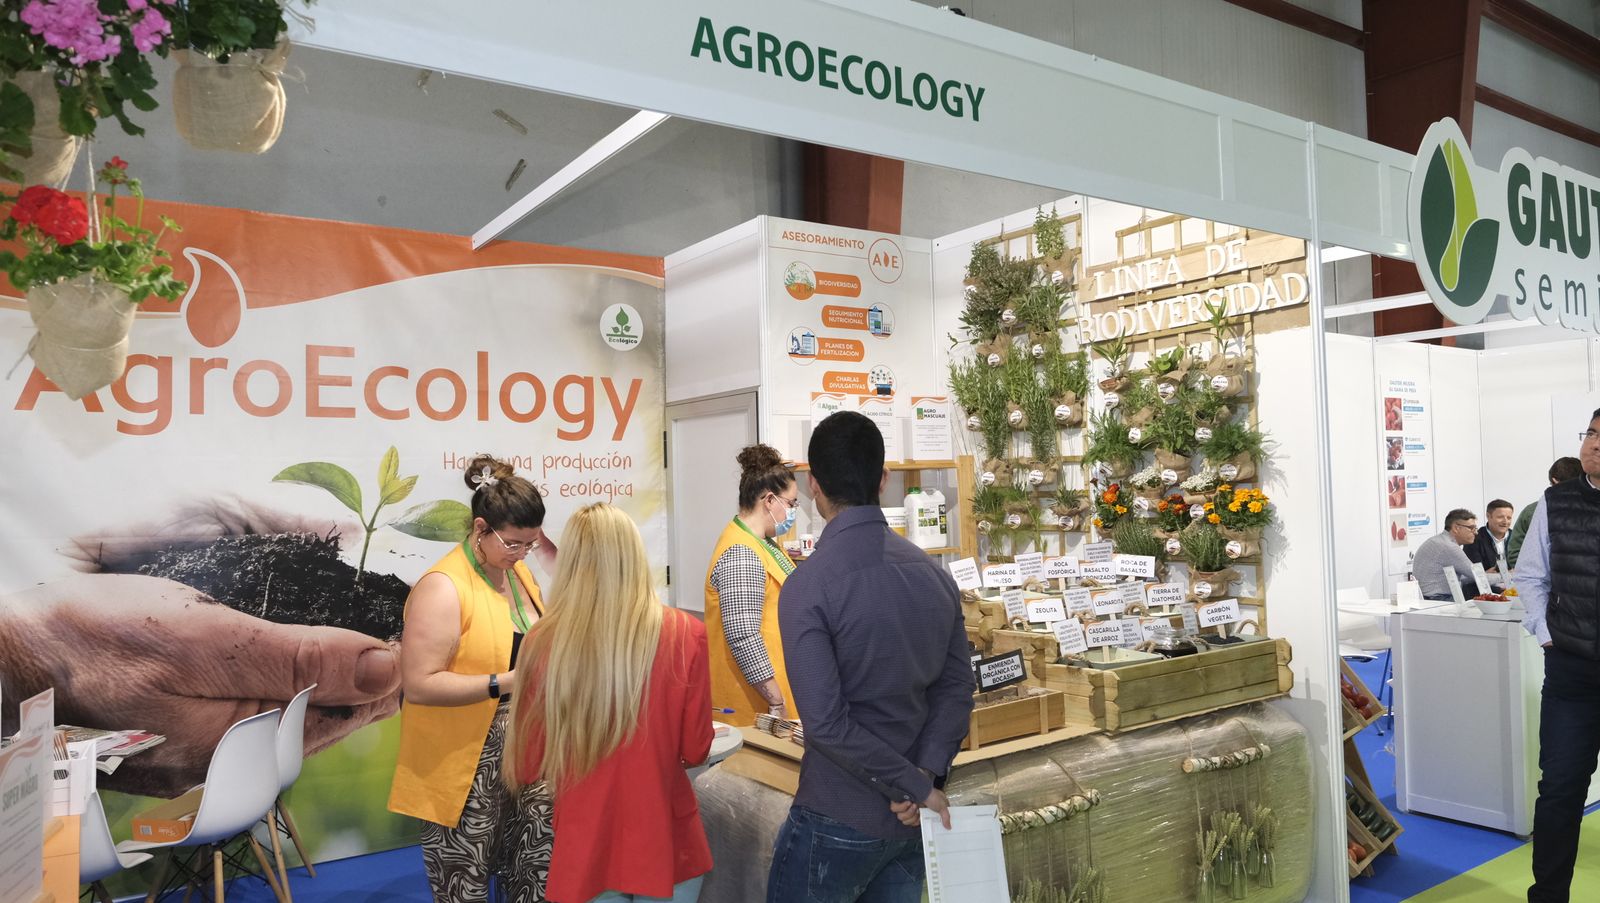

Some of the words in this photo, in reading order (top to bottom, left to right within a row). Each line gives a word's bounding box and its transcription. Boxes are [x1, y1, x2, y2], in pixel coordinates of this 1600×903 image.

[690, 16, 985, 122] AGROECOLOGY
[781, 231, 865, 250] ASESORAMIENTO
[1094, 254, 1186, 300] LINEA
[1205, 237, 1248, 276] DE
[818, 279, 858, 289] BIODIVERSIDAD
[1075, 272, 1309, 345] BIODIVERSIDAD
[828, 309, 864, 318] SEGUIMIENTO
[828, 316, 864, 325] NUTRICIONAL
[835, 375, 860, 383] CHARLAS
[828, 382, 866, 390] DIVULGATIVAS
[822, 403, 839, 411] Algas
[542, 451, 632, 478] producción
[559, 479, 633, 504] ecológica
[1120, 566, 1148, 574] BASALTO
[1151, 595, 1182, 603] DIATOMEAS
[1207, 614, 1233, 623] VEGETAL
[1088, 626, 1120, 635] CASCARILLA
[1101, 635, 1119, 643] ARROZ
[987, 658, 1015, 671] ENMIENDA
[992, 673, 1015, 684] BOCASHI
